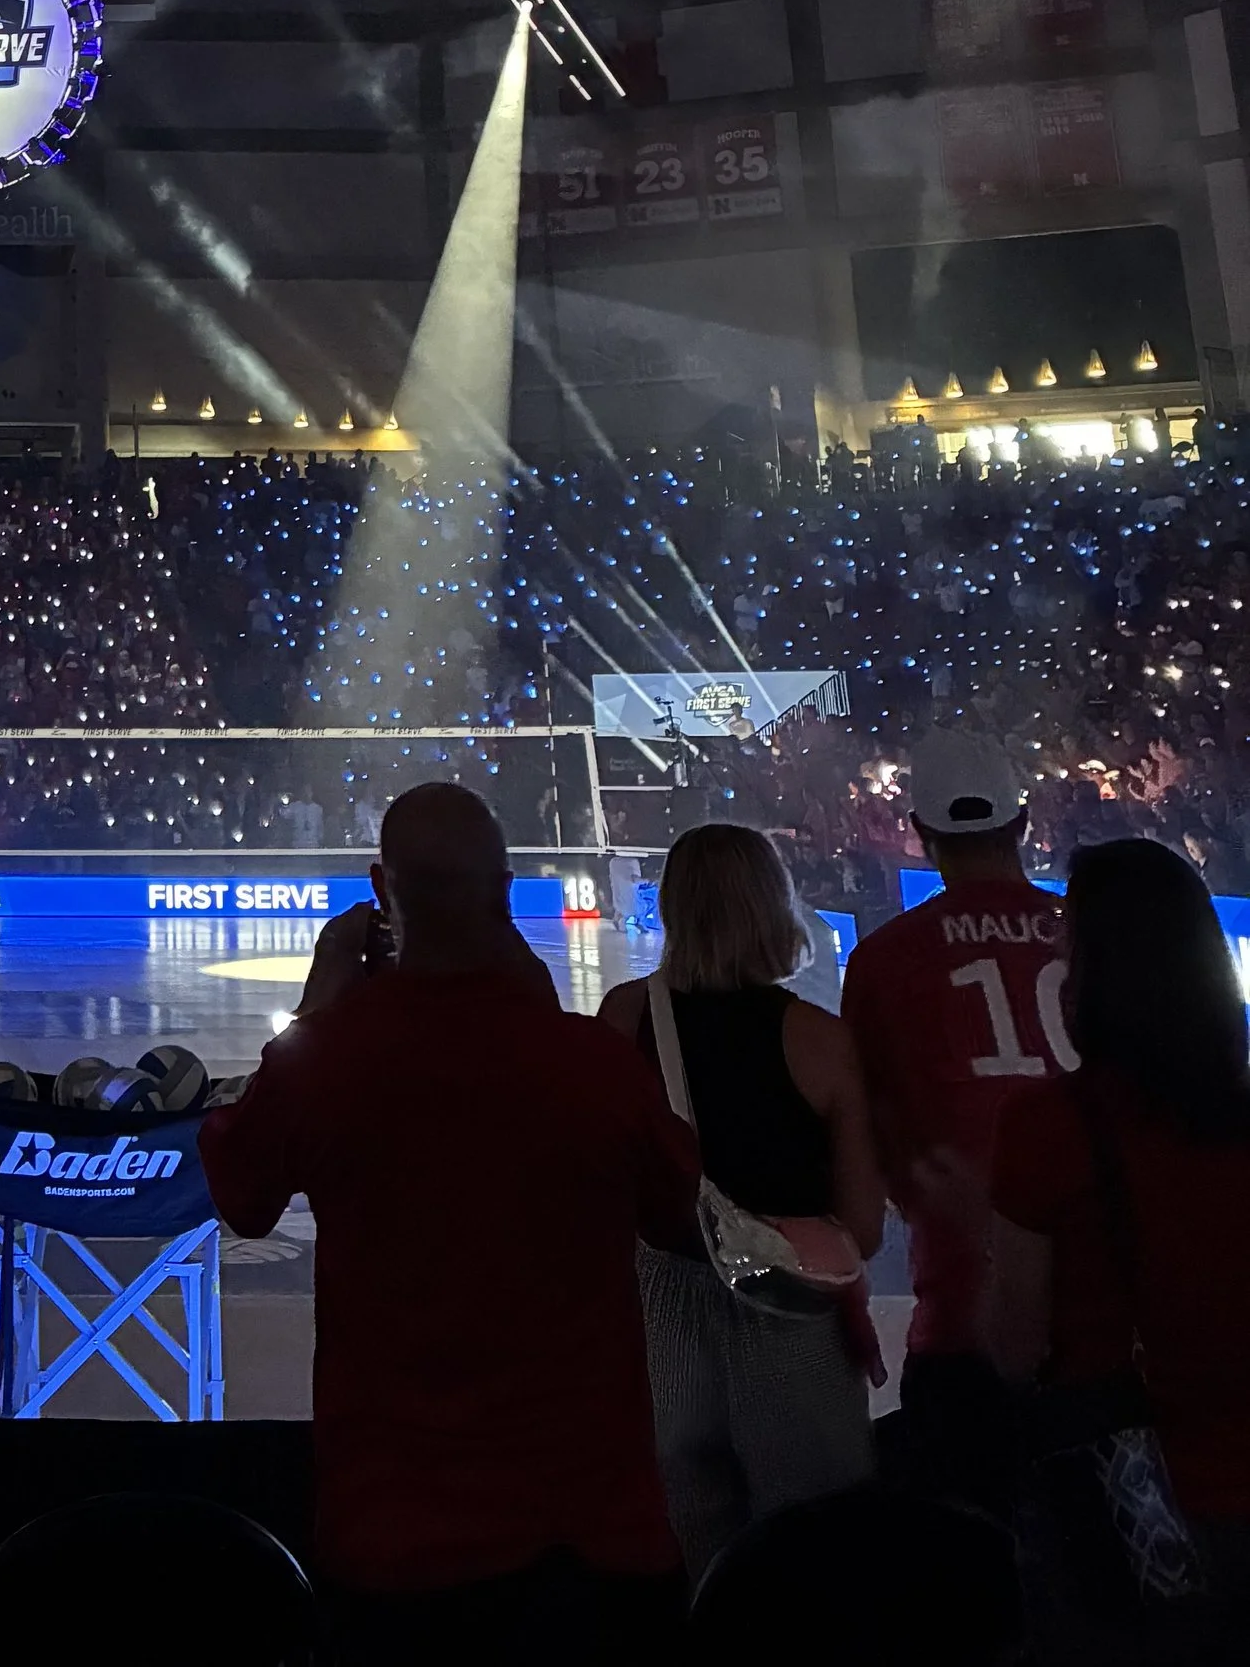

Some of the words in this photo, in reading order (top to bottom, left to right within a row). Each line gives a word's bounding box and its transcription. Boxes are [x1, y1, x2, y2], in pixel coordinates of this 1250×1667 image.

[635, 157, 686, 194] 23
[714, 146, 769, 185] 35
[686, 697, 716, 711] FIRST
[148, 884, 229, 910] FIRST
[235, 884, 329, 910] SERVE
[564, 877, 597, 911] 18
[44, 1186, 135, 1197] BADENSPORTS.COM
